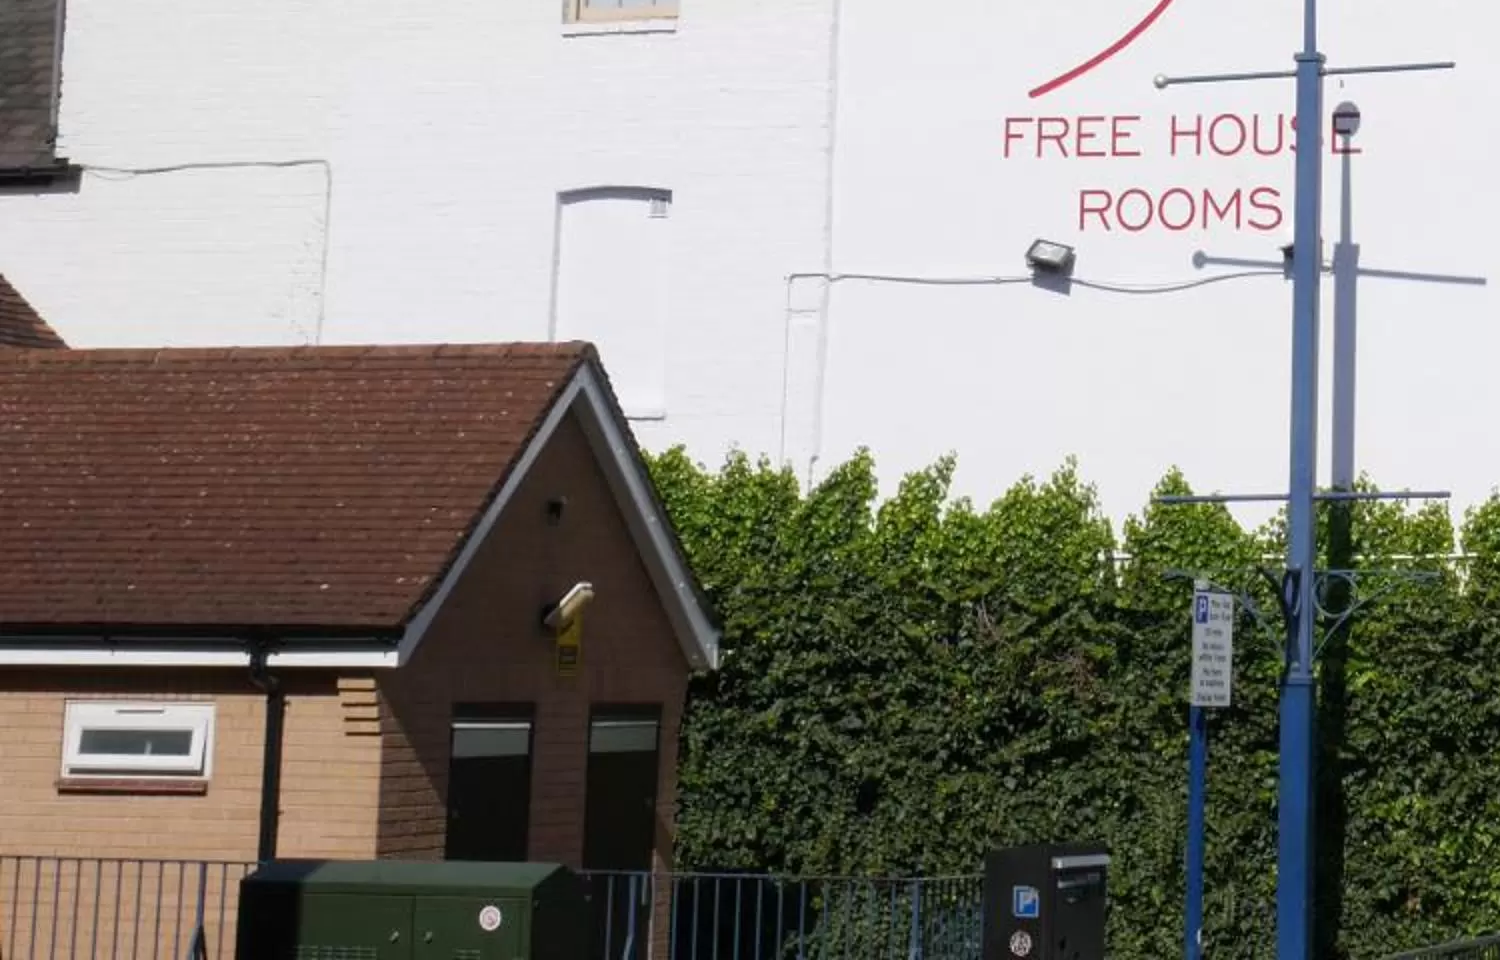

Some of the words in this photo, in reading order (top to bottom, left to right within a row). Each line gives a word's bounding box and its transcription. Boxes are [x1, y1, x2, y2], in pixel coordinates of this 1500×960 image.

[1003, 115, 1142, 158] FREE
[1170, 112, 1363, 156] HOUE
[1079, 186, 1284, 231] ROOMS
